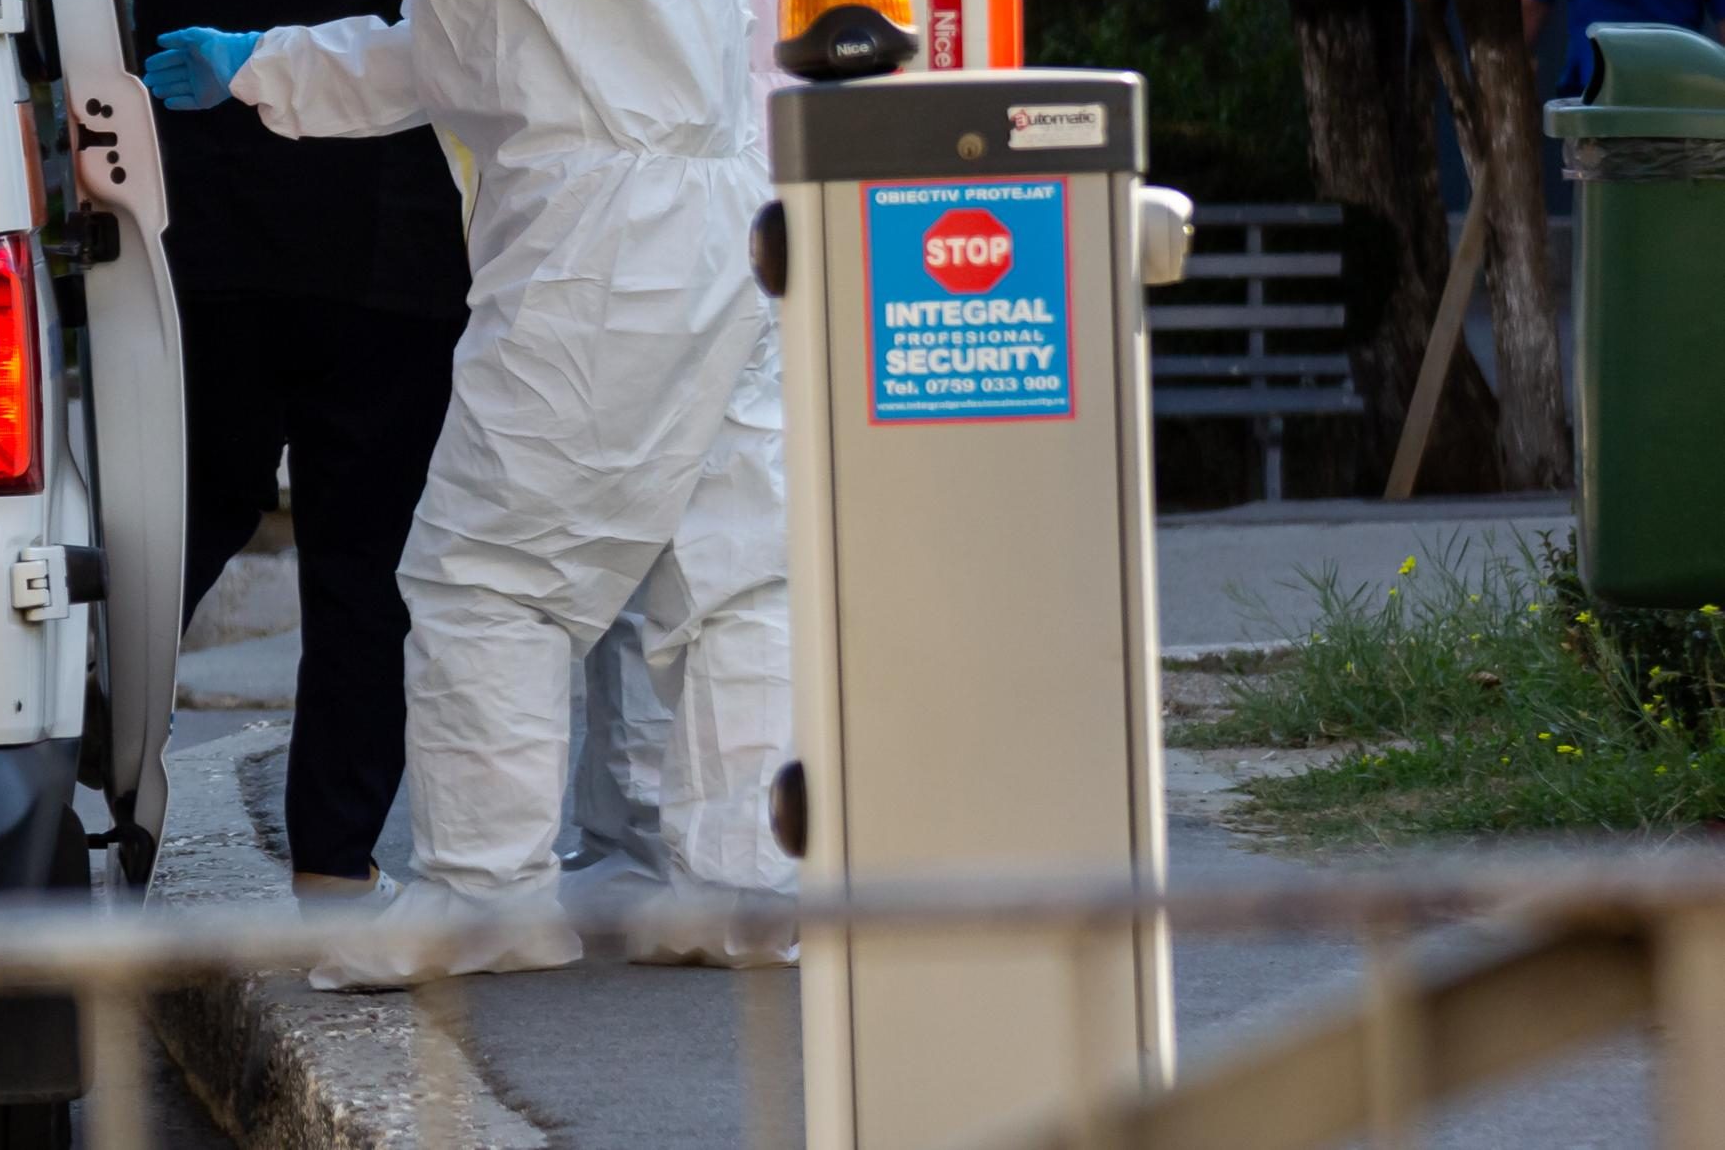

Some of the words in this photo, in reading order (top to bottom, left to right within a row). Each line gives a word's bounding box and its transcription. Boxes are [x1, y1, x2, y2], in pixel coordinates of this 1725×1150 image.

[836, 42, 869, 56] Nice
[934, 11, 956, 67] Nice
[876, 189, 959, 204] OBIECTIV
[965, 186, 1055, 201] PROTEJAT
[926, 236, 1009, 267] STOP
[885, 298, 1054, 327] INTEGRAL
[893, 330, 1045, 346] PROFESIONAL
[886, 344, 1055, 375] SECURITY
[883, 379, 919, 395] Tel.
[925, 378, 975, 394] 0759
[981, 377, 1018, 392] 033
[1024, 375, 1061, 391] 900
